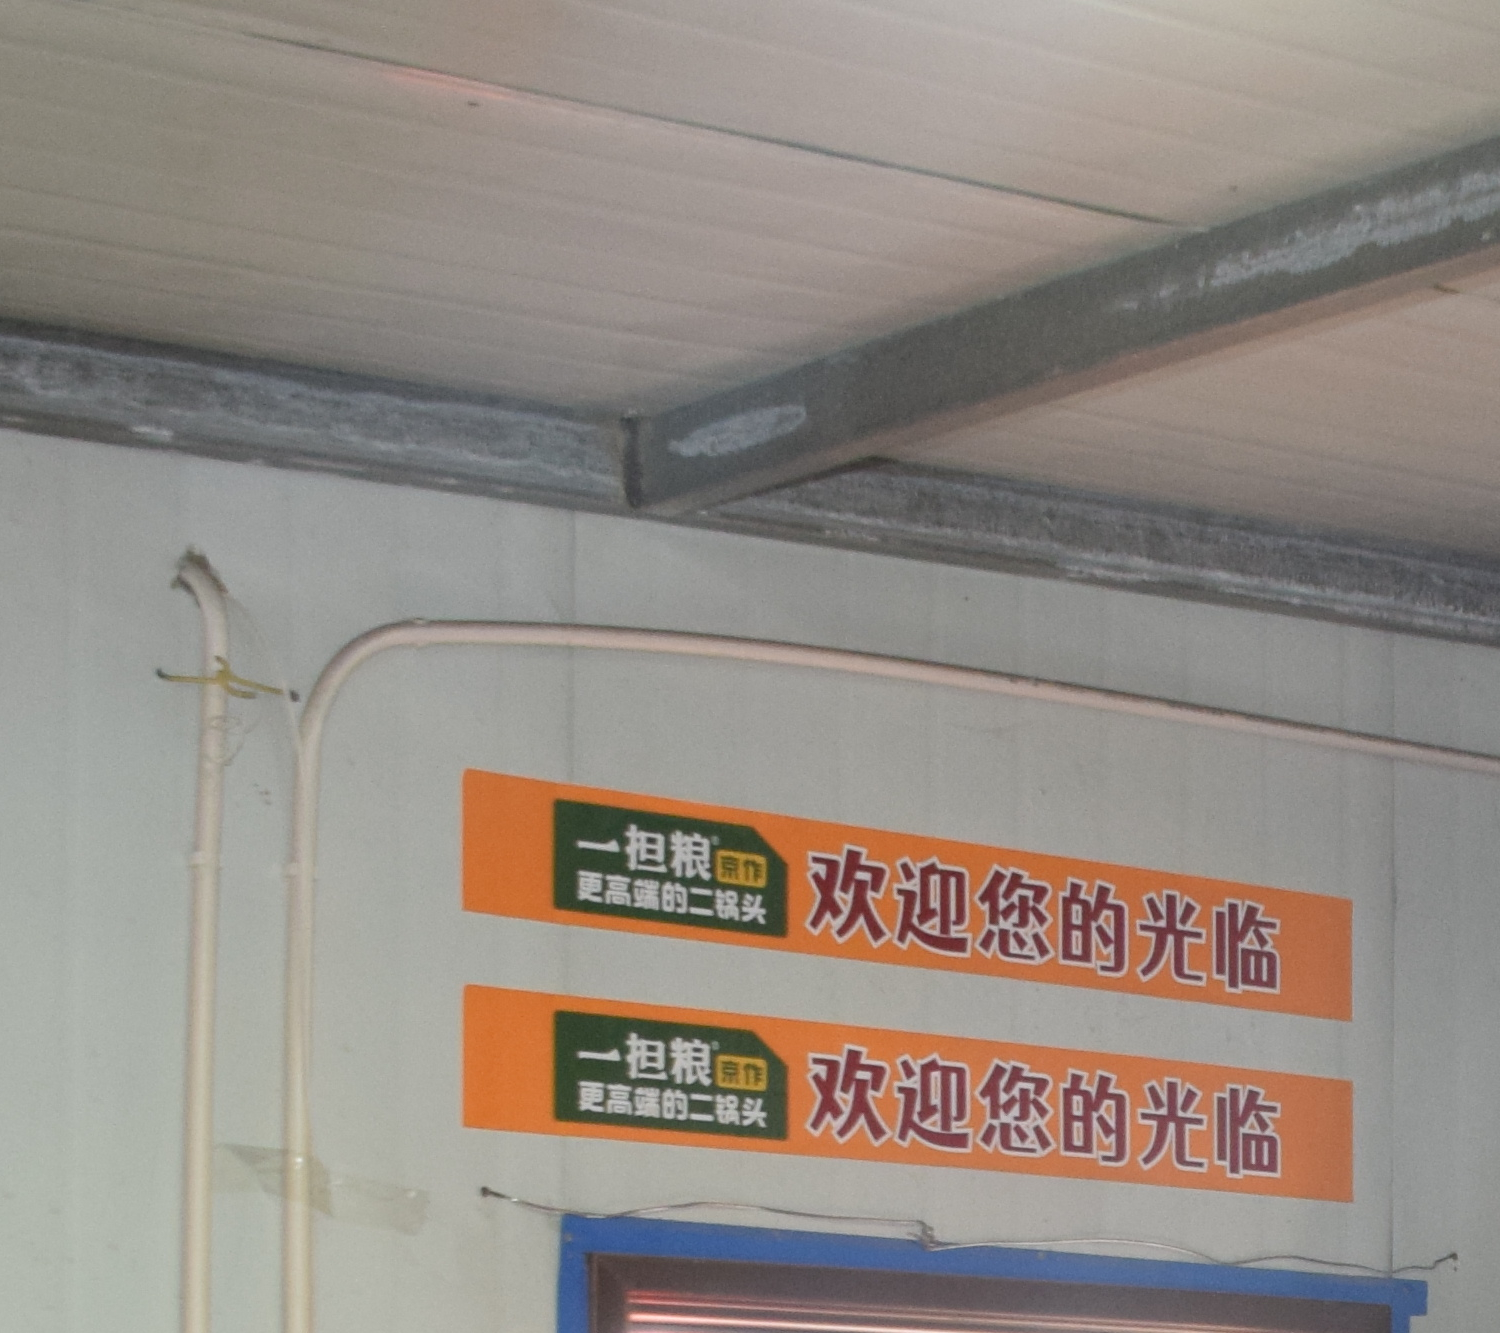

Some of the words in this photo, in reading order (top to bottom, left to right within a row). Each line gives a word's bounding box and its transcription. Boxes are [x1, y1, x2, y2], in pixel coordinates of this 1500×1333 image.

[576, 824, 713, 881] 一担粮
[719, 853, 765, 884] 京作
[577, 869, 767, 925] 更高端的二锅头
[806, 844, 1281, 993] 欢迎您的光临
[577, 1032, 713, 1087] 一担粮
[720, 1058, 765, 1088] 京作
[578, 1080, 768, 1129] 更高端的二锅头
[806, 1044, 1282, 1178] 欢迎您的光临
